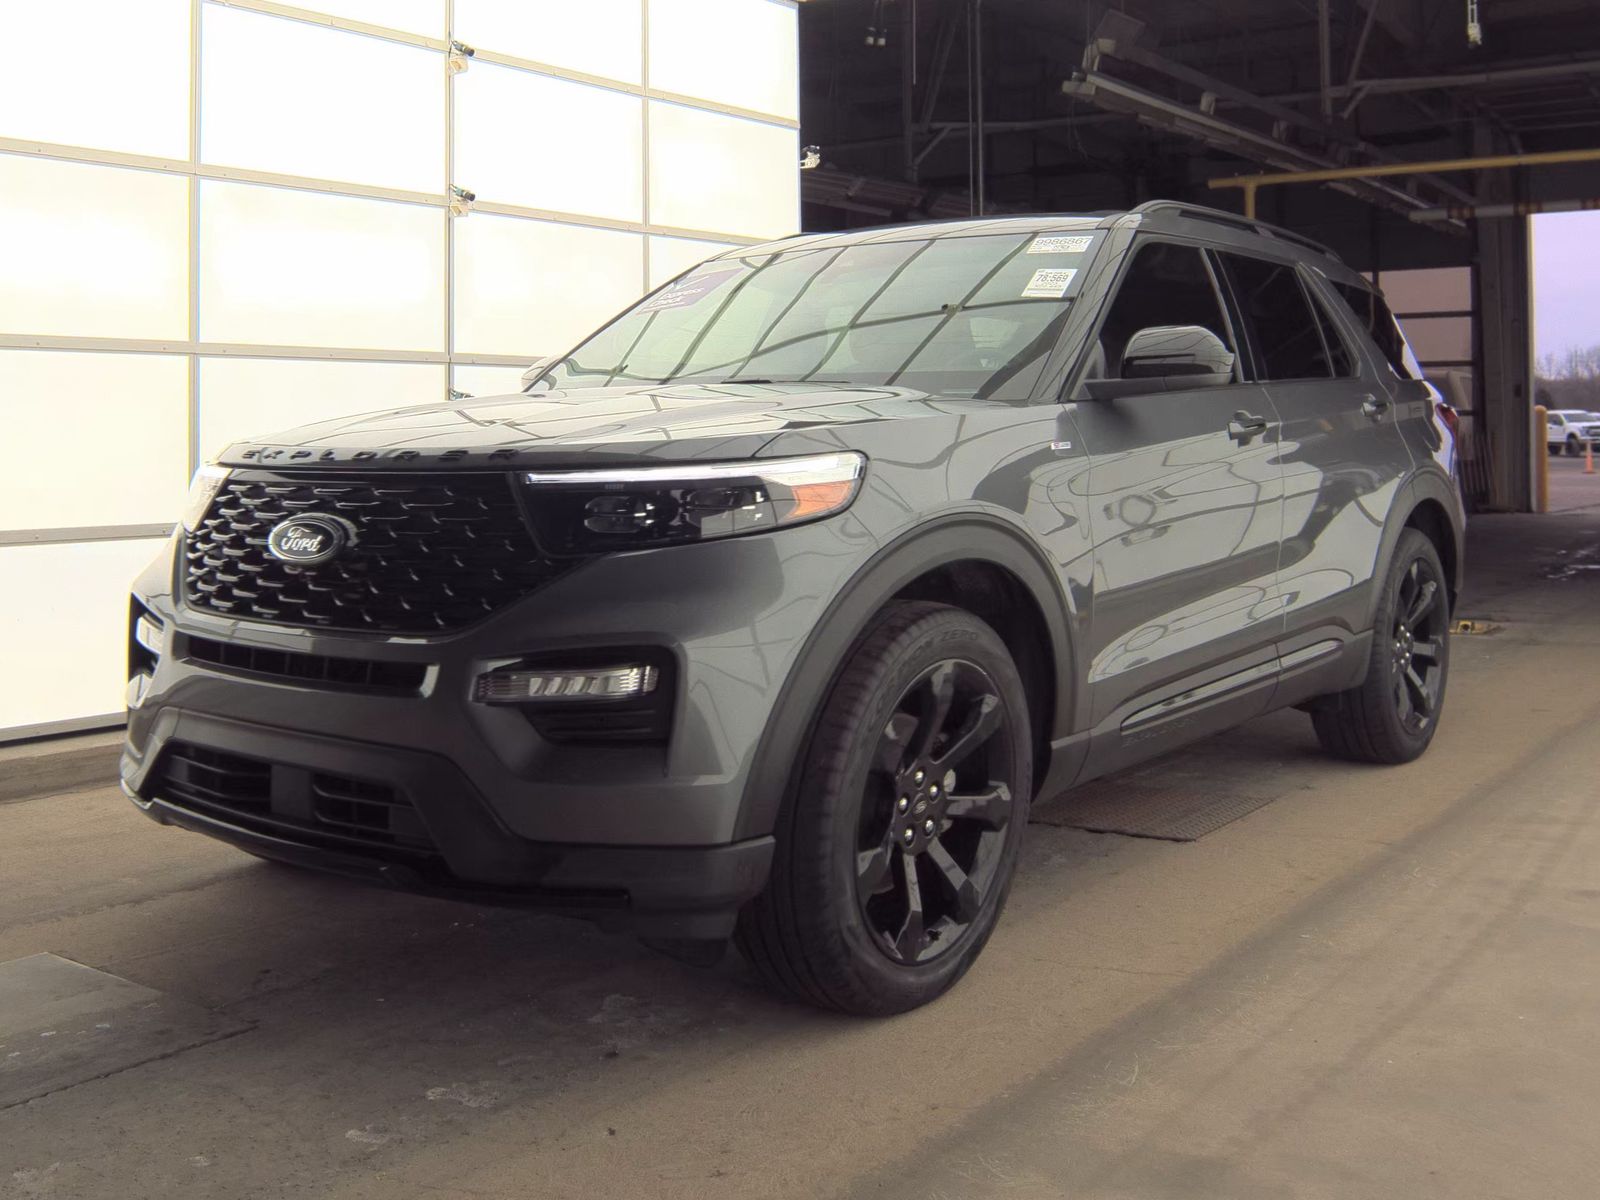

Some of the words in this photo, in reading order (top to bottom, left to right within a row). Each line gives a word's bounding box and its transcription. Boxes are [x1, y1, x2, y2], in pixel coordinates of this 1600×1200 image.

[1036, 238, 1089, 246] 9986867
[241, 449, 519, 461] EXPLORER
[280, 526, 324, 552] Ford
